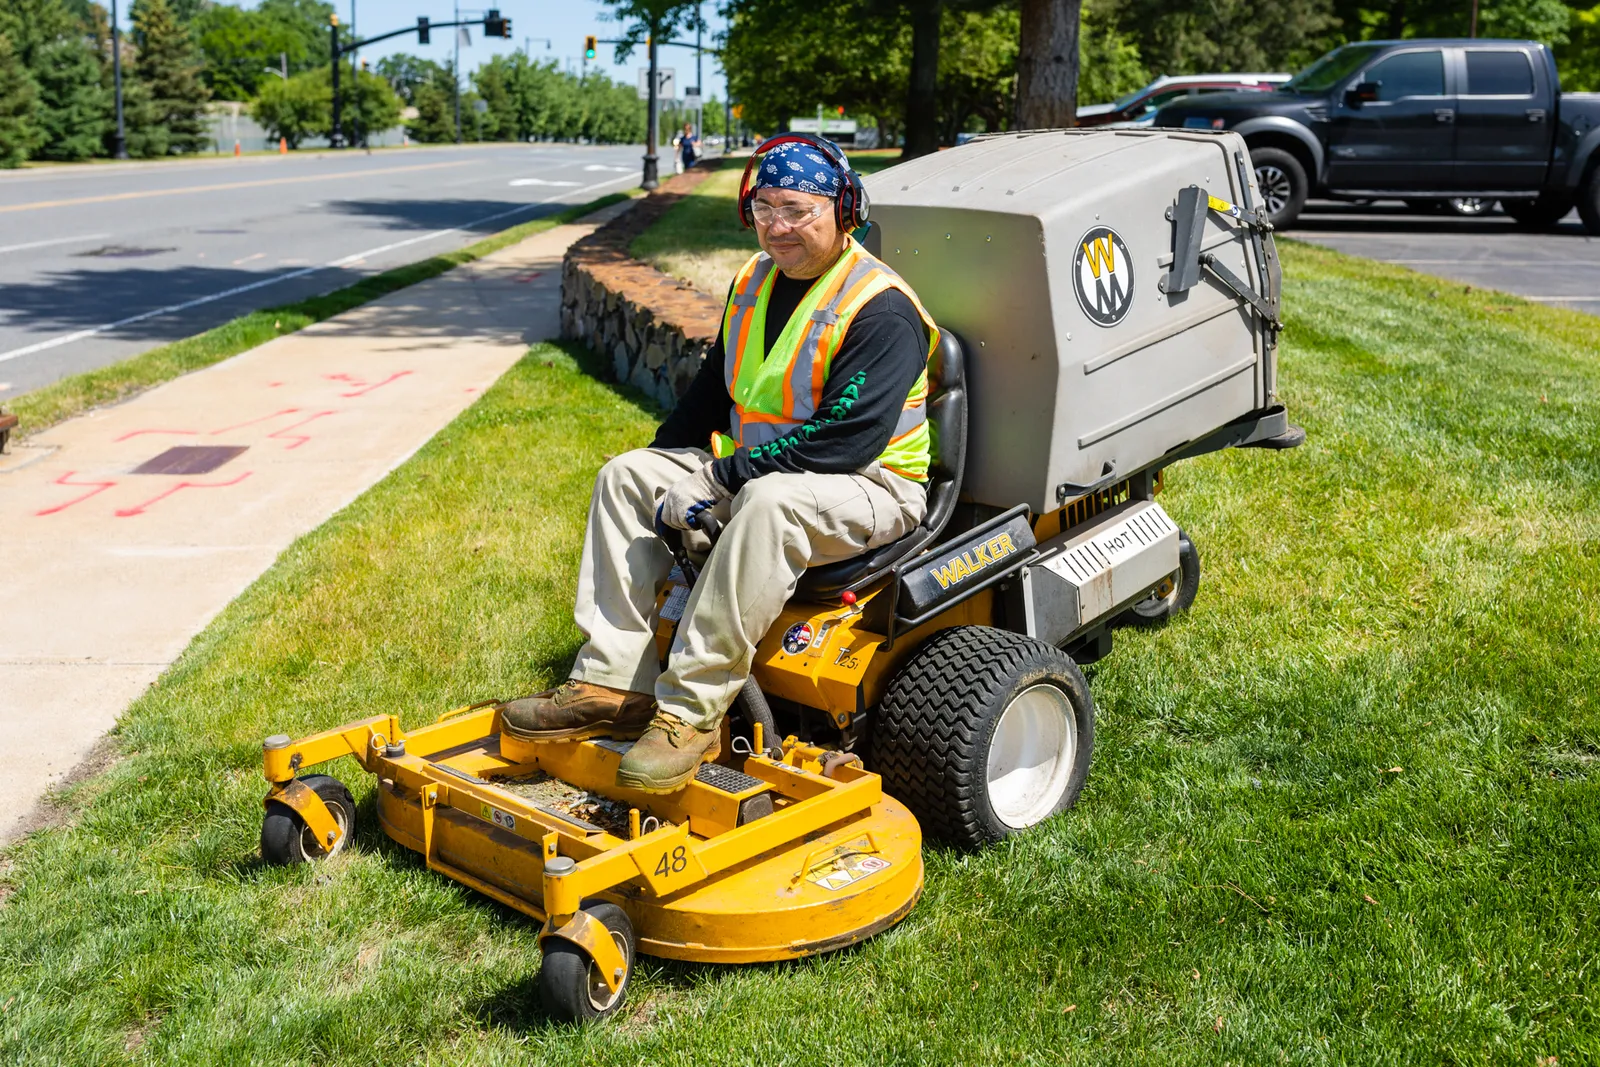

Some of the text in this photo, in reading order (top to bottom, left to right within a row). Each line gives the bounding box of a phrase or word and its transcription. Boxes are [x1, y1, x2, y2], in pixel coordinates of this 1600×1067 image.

[1104, 531, 1133, 555] HOT
[930, 532, 1017, 590] WALKER
[654, 846, 687, 877] 48
